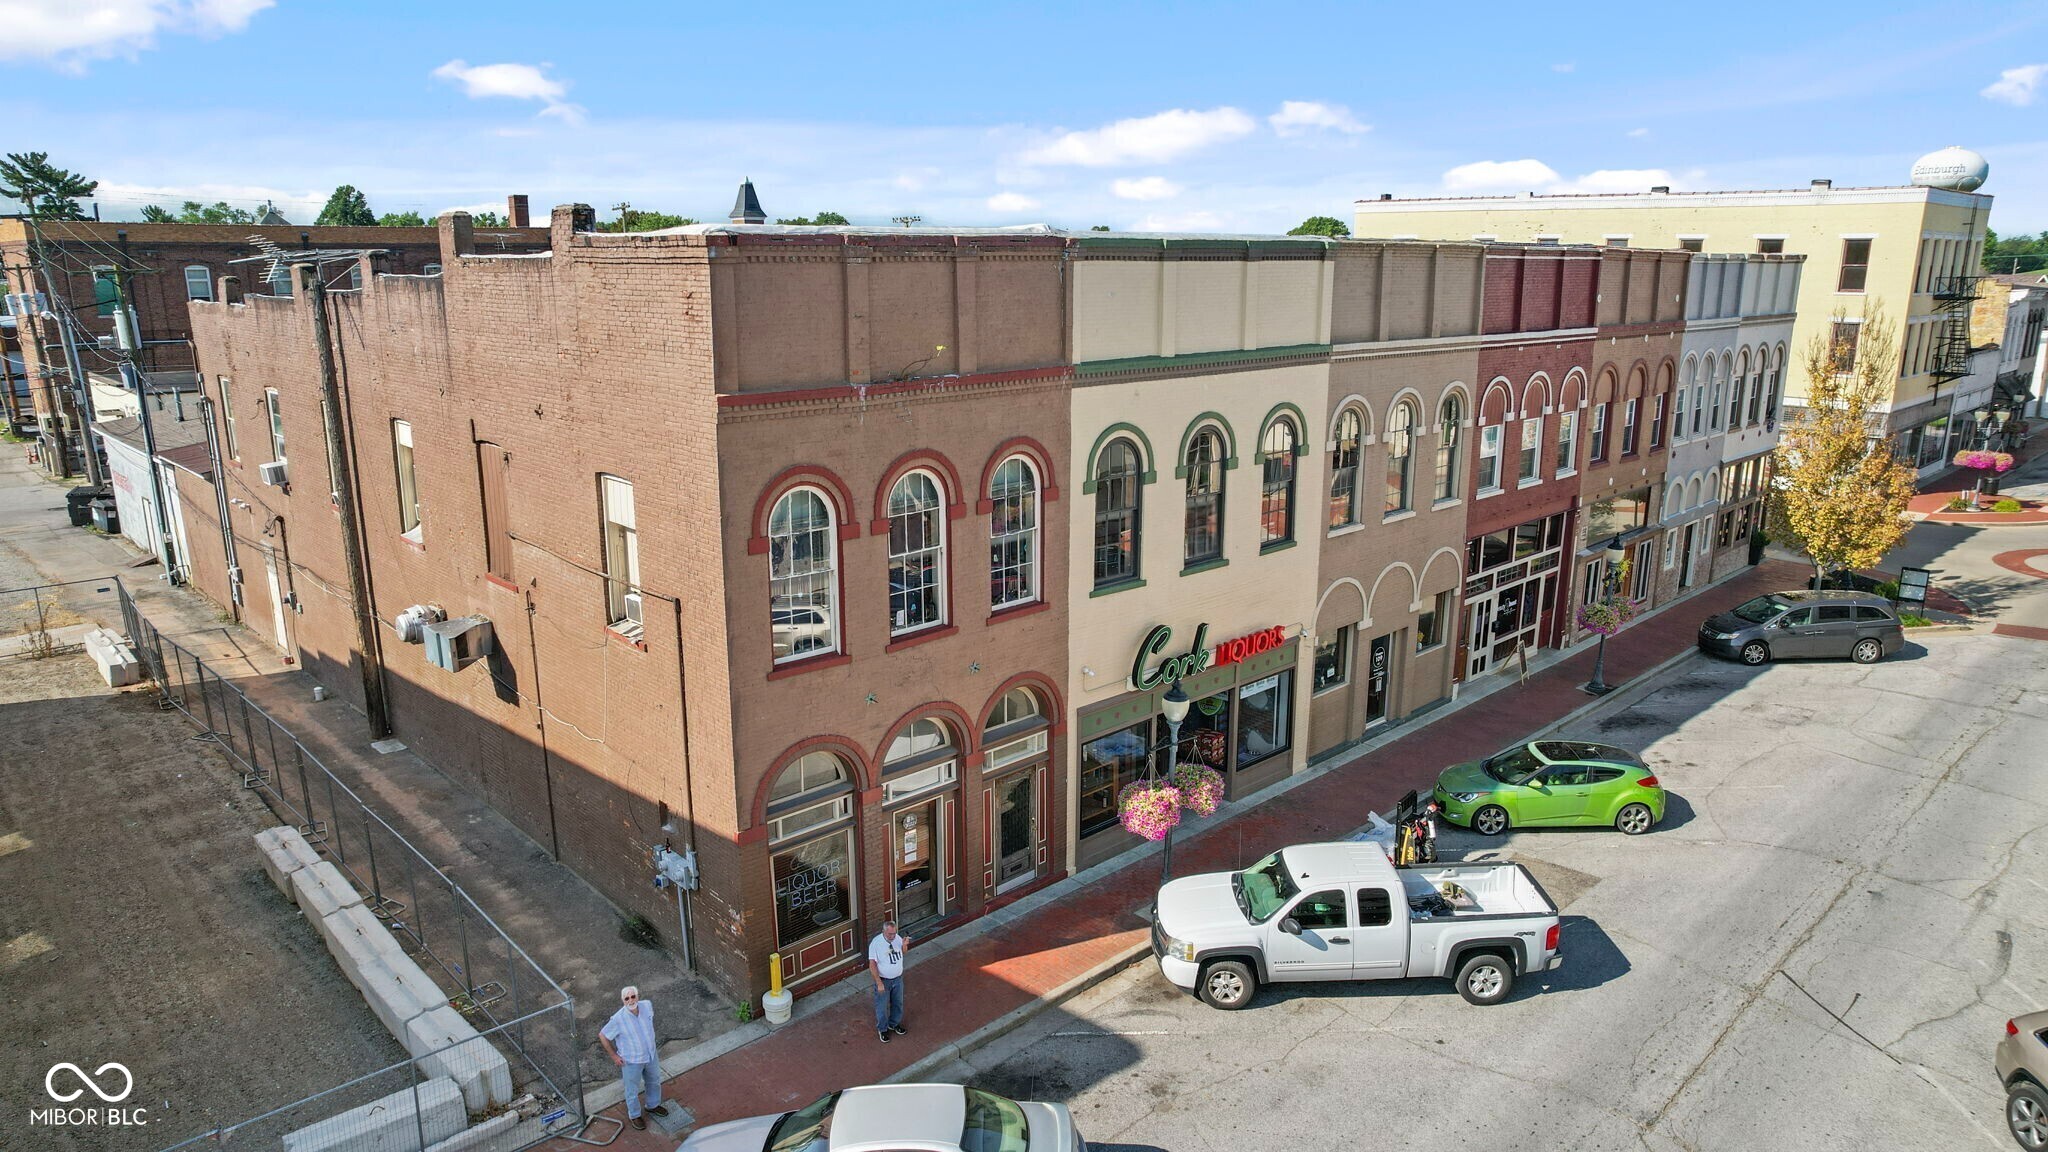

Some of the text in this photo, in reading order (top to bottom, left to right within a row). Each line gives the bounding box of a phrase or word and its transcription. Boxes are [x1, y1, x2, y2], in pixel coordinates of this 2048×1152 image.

[1915, 164, 1966, 175] Edinburgh
[1132, 623, 1210, 692] Cork
[1215, 625, 1285, 667] LIQUORS
[777, 860, 841, 893] LIQUOR
[791, 878, 837, 909] BEER
